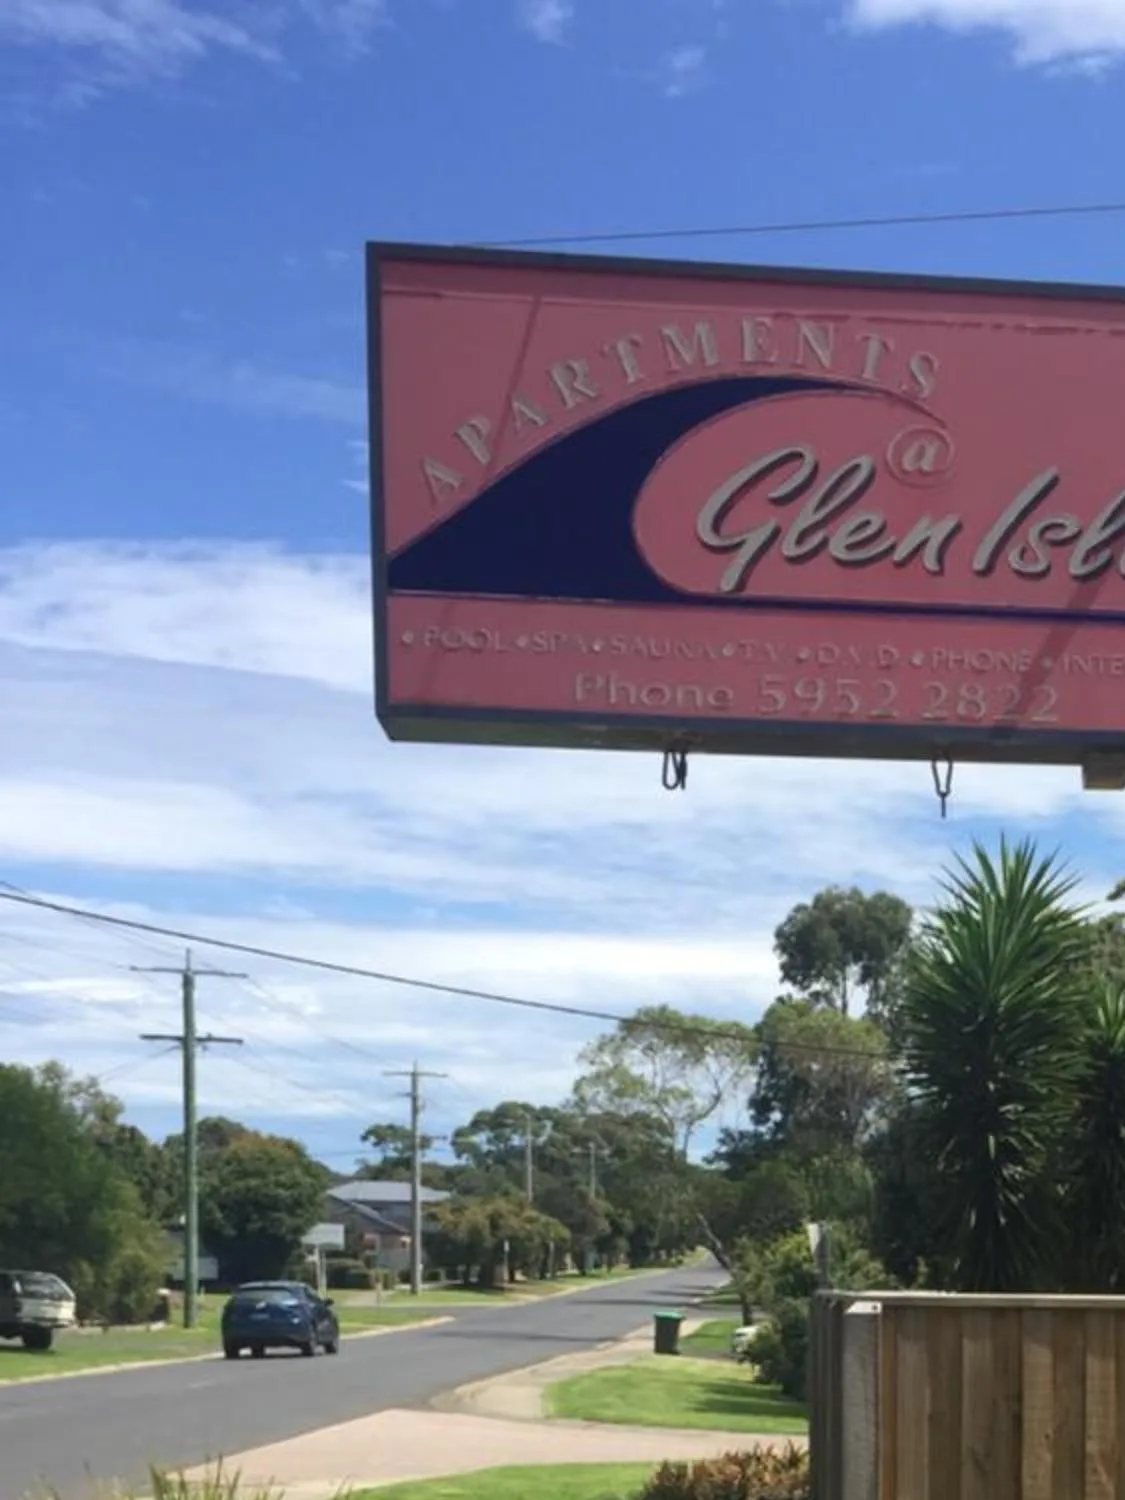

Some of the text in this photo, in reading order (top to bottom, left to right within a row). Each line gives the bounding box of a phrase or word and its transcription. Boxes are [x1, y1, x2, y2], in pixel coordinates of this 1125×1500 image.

[417, 317, 944, 503] APARTMENTS
[886, 422, 953, 488] @
[696, 446, 962, 594] Glen
[423, 624, 511, 654] POOL
[610, 634, 718, 660] SAUNA
[931, 646, 1033, 675] PHONE
[574, 672, 1060, 723] Phone 5952 2822
